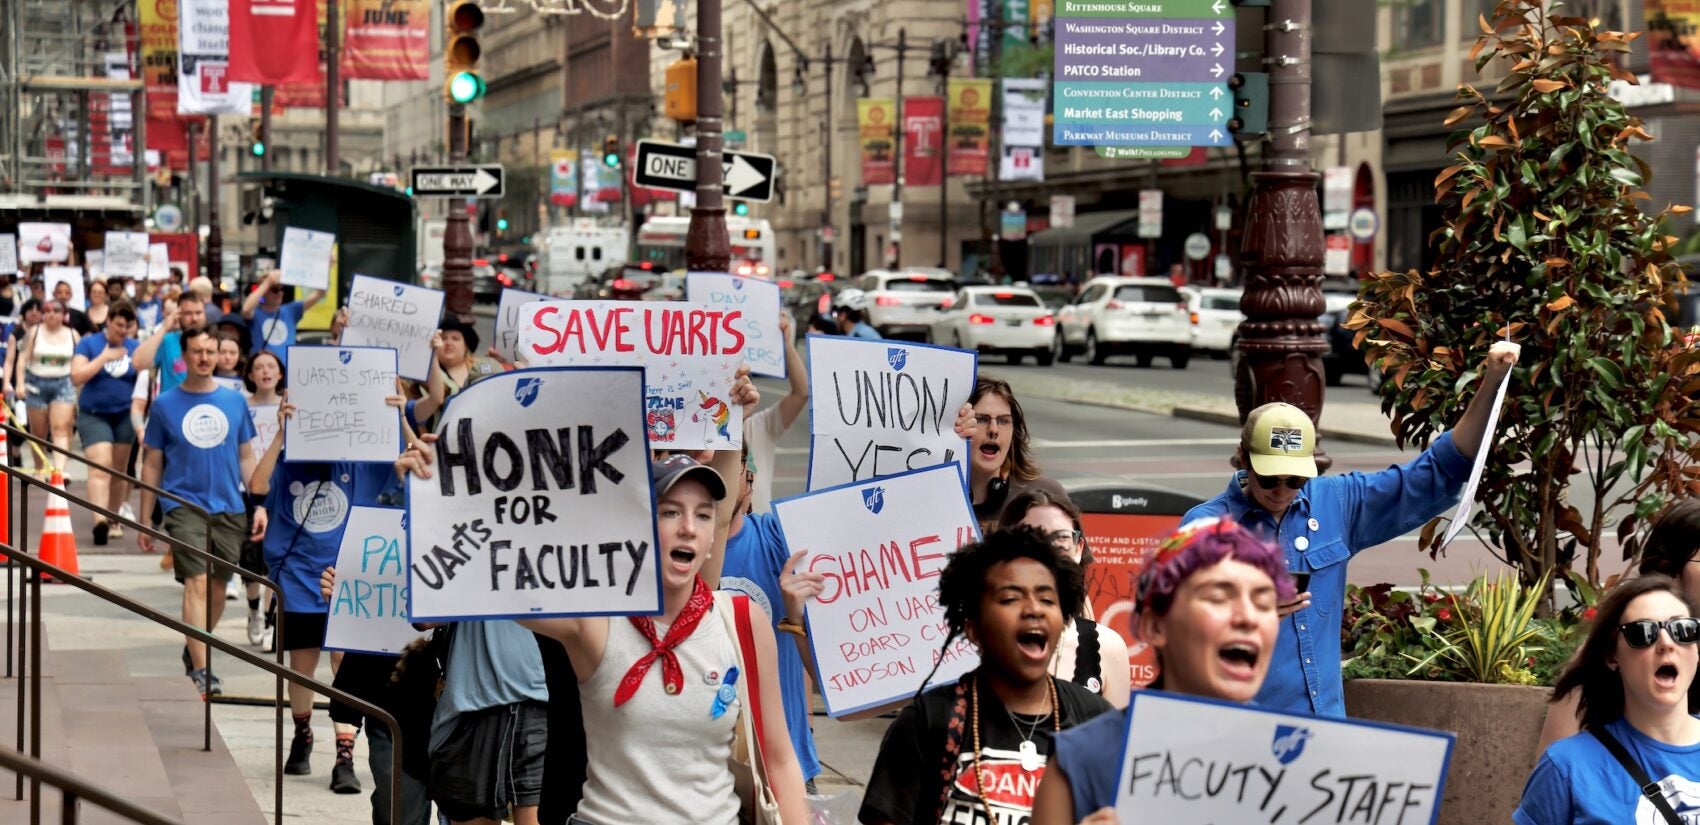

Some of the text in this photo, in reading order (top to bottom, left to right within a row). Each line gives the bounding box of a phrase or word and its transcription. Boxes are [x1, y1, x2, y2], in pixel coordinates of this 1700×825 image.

[363, 9, 410, 25] JUNE
[1066, 2, 1162, 12] RITTENHOUSE SQUARE
[192, 23, 228, 34] chang
[1066, 23, 1203, 34] WASHINGTON SQUARE DISTRICT
[1064, 44, 1206, 58] Historical Soc./Library Co.
[1064, 65, 1141, 76] PATCO Station
[1064, 87, 1201, 99] CONVENTION CENTER DISTRICT
[1064, 108, 1183, 121] Market East Shopping
[907, 117, 940, 157] T
[1064, 130, 1192, 141] PARKWAY MUSEUMS DISTRICT
[651, 156, 688, 177] ONE
[420, 175, 474, 187] ONE WAY
[354, 291, 418, 315] SHARED
[350, 309, 433, 340] GOVERNANCE
[532, 306, 635, 355] SAVE
[643, 309, 745, 356] UARTS
[297, 366, 397, 386] UARTS STAFF
[328, 392, 359, 406] ARE
[515, 378, 545, 402] aft
[647, 396, 684, 410] TIME
[833, 369, 949, 436] UNION
[297, 409, 366, 429] PEOPLE
[344, 425, 391, 448] TOO!!
[435, 418, 630, 496] HONK
[494, 495, 558, 525] FOR
[865, 486, 885, 511] aft
[361, 535, 403, 576] PA
[490, 540, 649, 597] FACULTY
[848, 593, 944, 633] ON UAR
[840, 633, 911, 663] BOARD
[828, 656, 916, 692] JUDSON
[1130, 665, 1154, 679] TIS
[980, 769, 1042, 798] DAN
[1130, 749, 1289, 825] FACUTY,
[1298, 769, 1432, 825] STAFF
